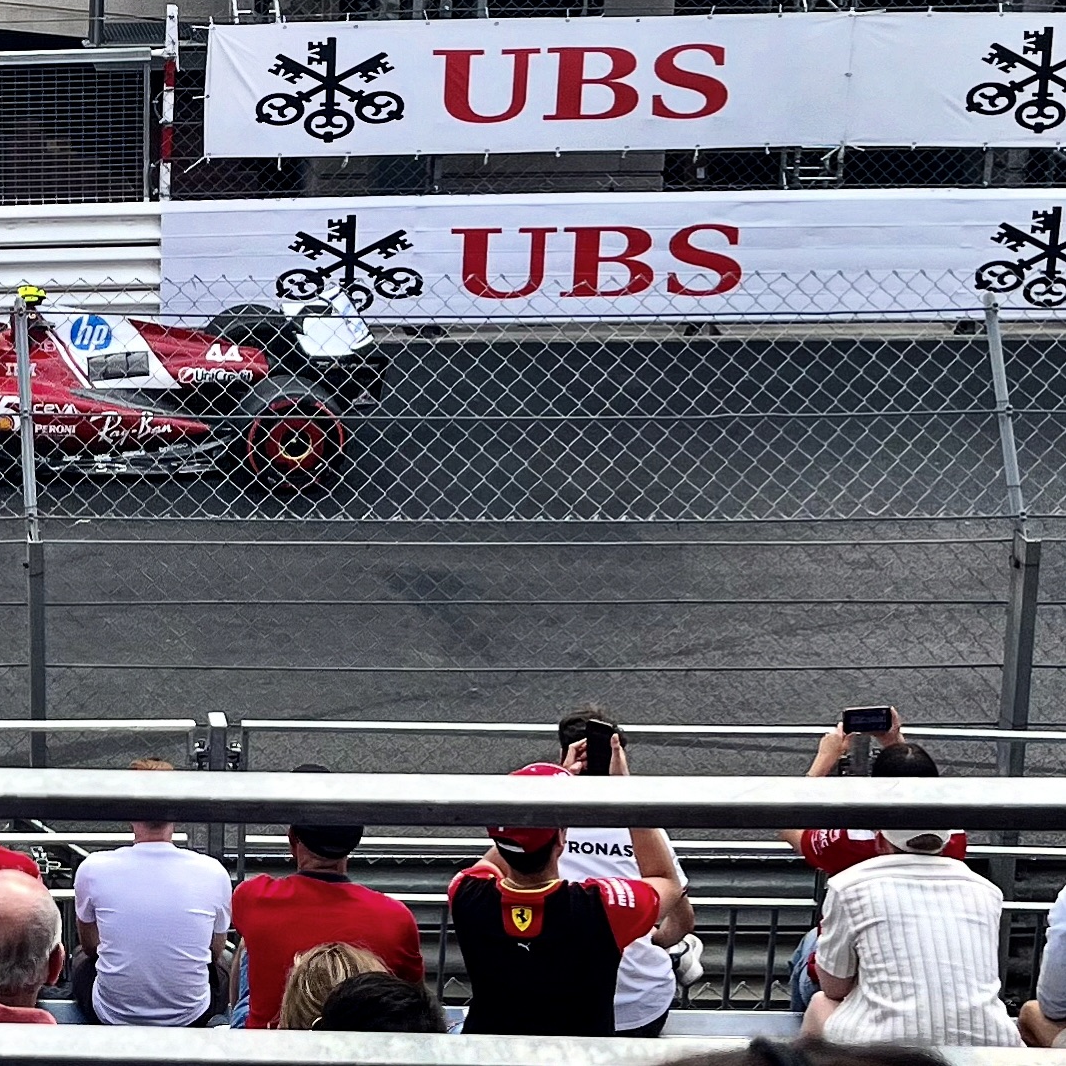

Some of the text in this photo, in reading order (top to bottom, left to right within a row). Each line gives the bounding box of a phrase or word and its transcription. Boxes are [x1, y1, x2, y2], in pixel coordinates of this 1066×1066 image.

[433, 44, 730, 124] UBS
[451, 222, 743, 299] UBS
[73, 315, 110, 350] hp
[206, 343, 244, 362] 44
[34, 423, 76, 434] PERONI
[90, 412, 173, 446] Ray-Ban
